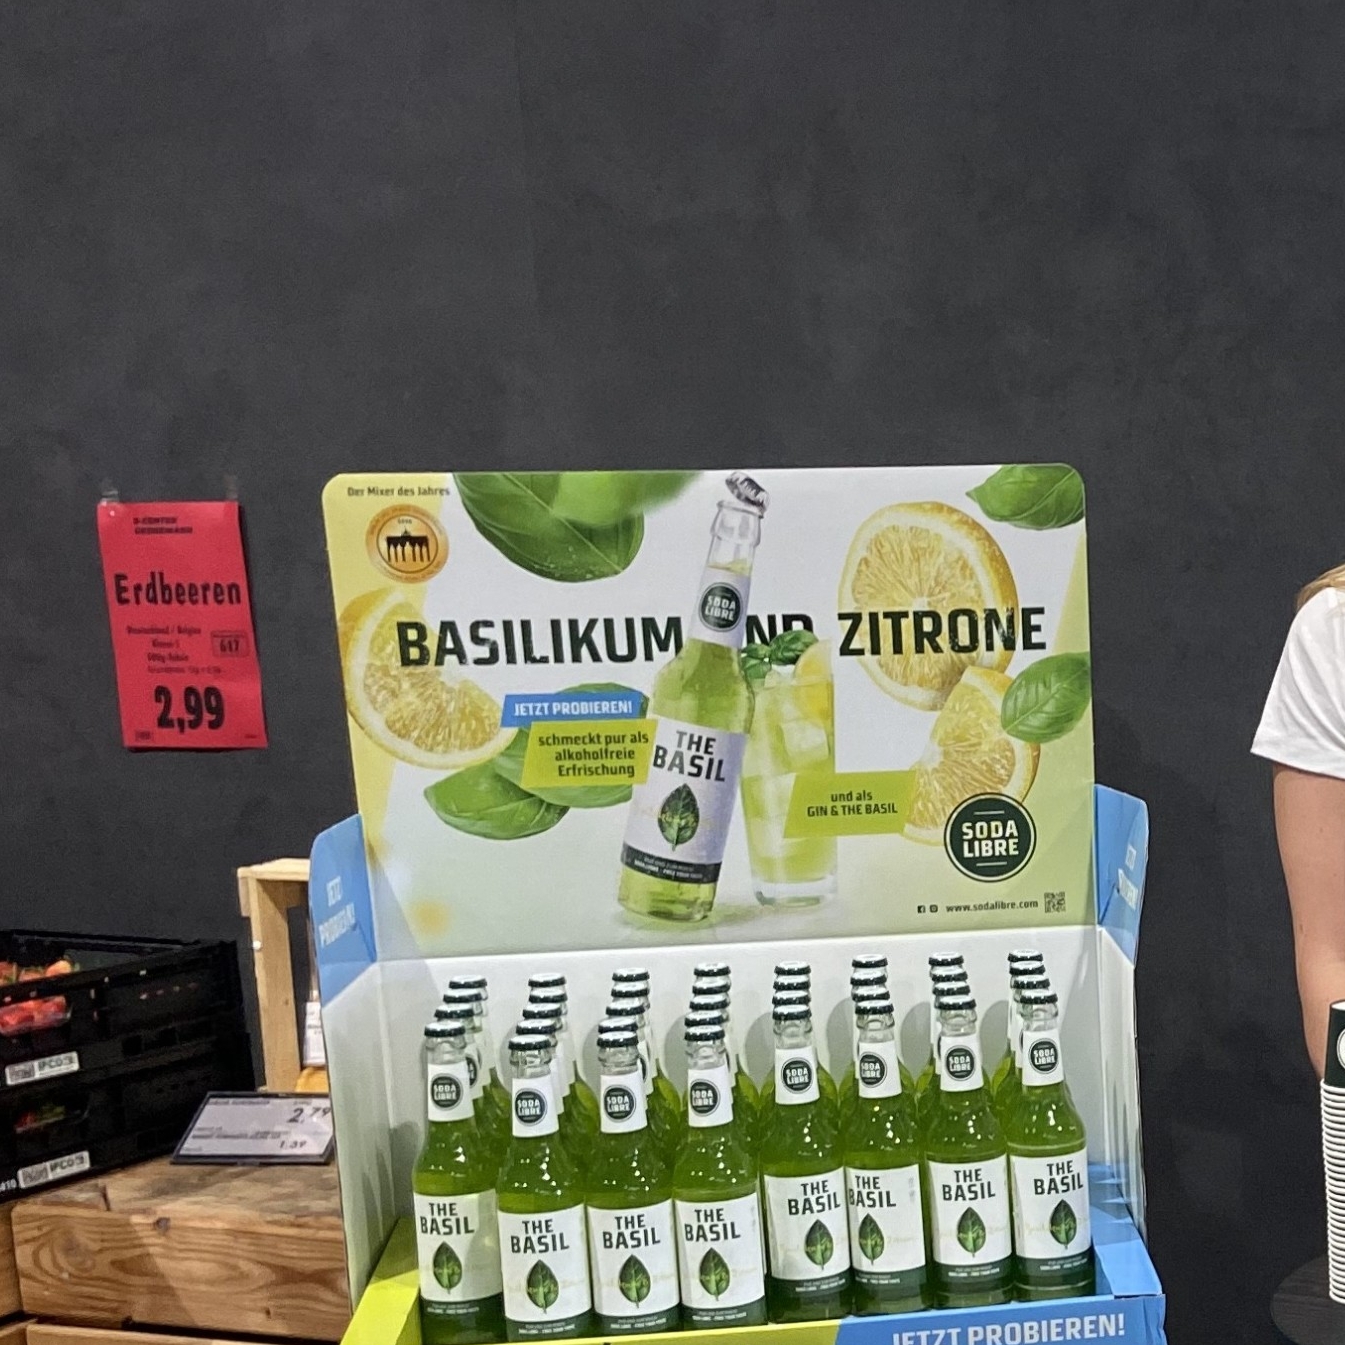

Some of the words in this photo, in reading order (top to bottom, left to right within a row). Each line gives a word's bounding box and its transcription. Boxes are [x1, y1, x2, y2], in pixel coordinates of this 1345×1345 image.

[347, 487, 365, 497] Der
[367, 487, 395, 496] Mixer
[397, 486, 415, 496] des
[417, 486, 450, 496] Jahres
[113, 571, 241, 606] Erdbeeren
[707, 595, 737, 610] SODA
[704, 606, 735, 622] LIBRE
[396, 616, 684, 667] BASILIKUM
[837, 606, 1047, 658] ZITRONE
[154, 684, 226, 734] 2,99
[514, 702, 550, 717] JETZT
[552, 699, 633, 715] PROBIEREN!
[537, 731, 603, 747] schmeckt
[604, 733, 627, 750] pur
[630, 731, 649, 744] als
[676, 729, 717, 755] THE
[554, 748, 636, 762] alkoholfreie
[652, 744, 726, 783] BASIL
[557, 763, 636, 778] Erfrischung
[831, 790, 853, 803] und
[855, 789, 873, 802] als
[807, 805, 828, 818] GIN
[830, 805, 839, 817] &
[841, 804, 863, 816] THE
[864, 802, 898, 815] BASIL
[961, 819, 1019, 840] SODA
[962, 837, 1020, 859] LIBRE
[945, 899, 1039, 913] www.sodalibre.com
[953, 1168, 983, 1185] THE
[1046, 1160, 1074, 1176] THE
[800, 1180, 829, 1196] THE
[854, 1175, 881, 1190] THE
[1033, 1173, 1084, 1196] BASIL
[848, 1189, 897, 1209] BASIL
[941, 1182, 996, 1202] BASIL
[428, 1202, 458, 1217] THE
[787, 1193, 841, 1217] BASIL
[614, 1214, 646, 1230] THE
[694, 1208, 725, 1224] THE
[419, 1215, 475, 1236] BASIL
[521, 1218, 554, 1234] THE
[684, 1220, 741, 1242] BASIL
[510, 1231, 570, 1255] BASIL
[602, 1228, 661, 1250] BASIL
